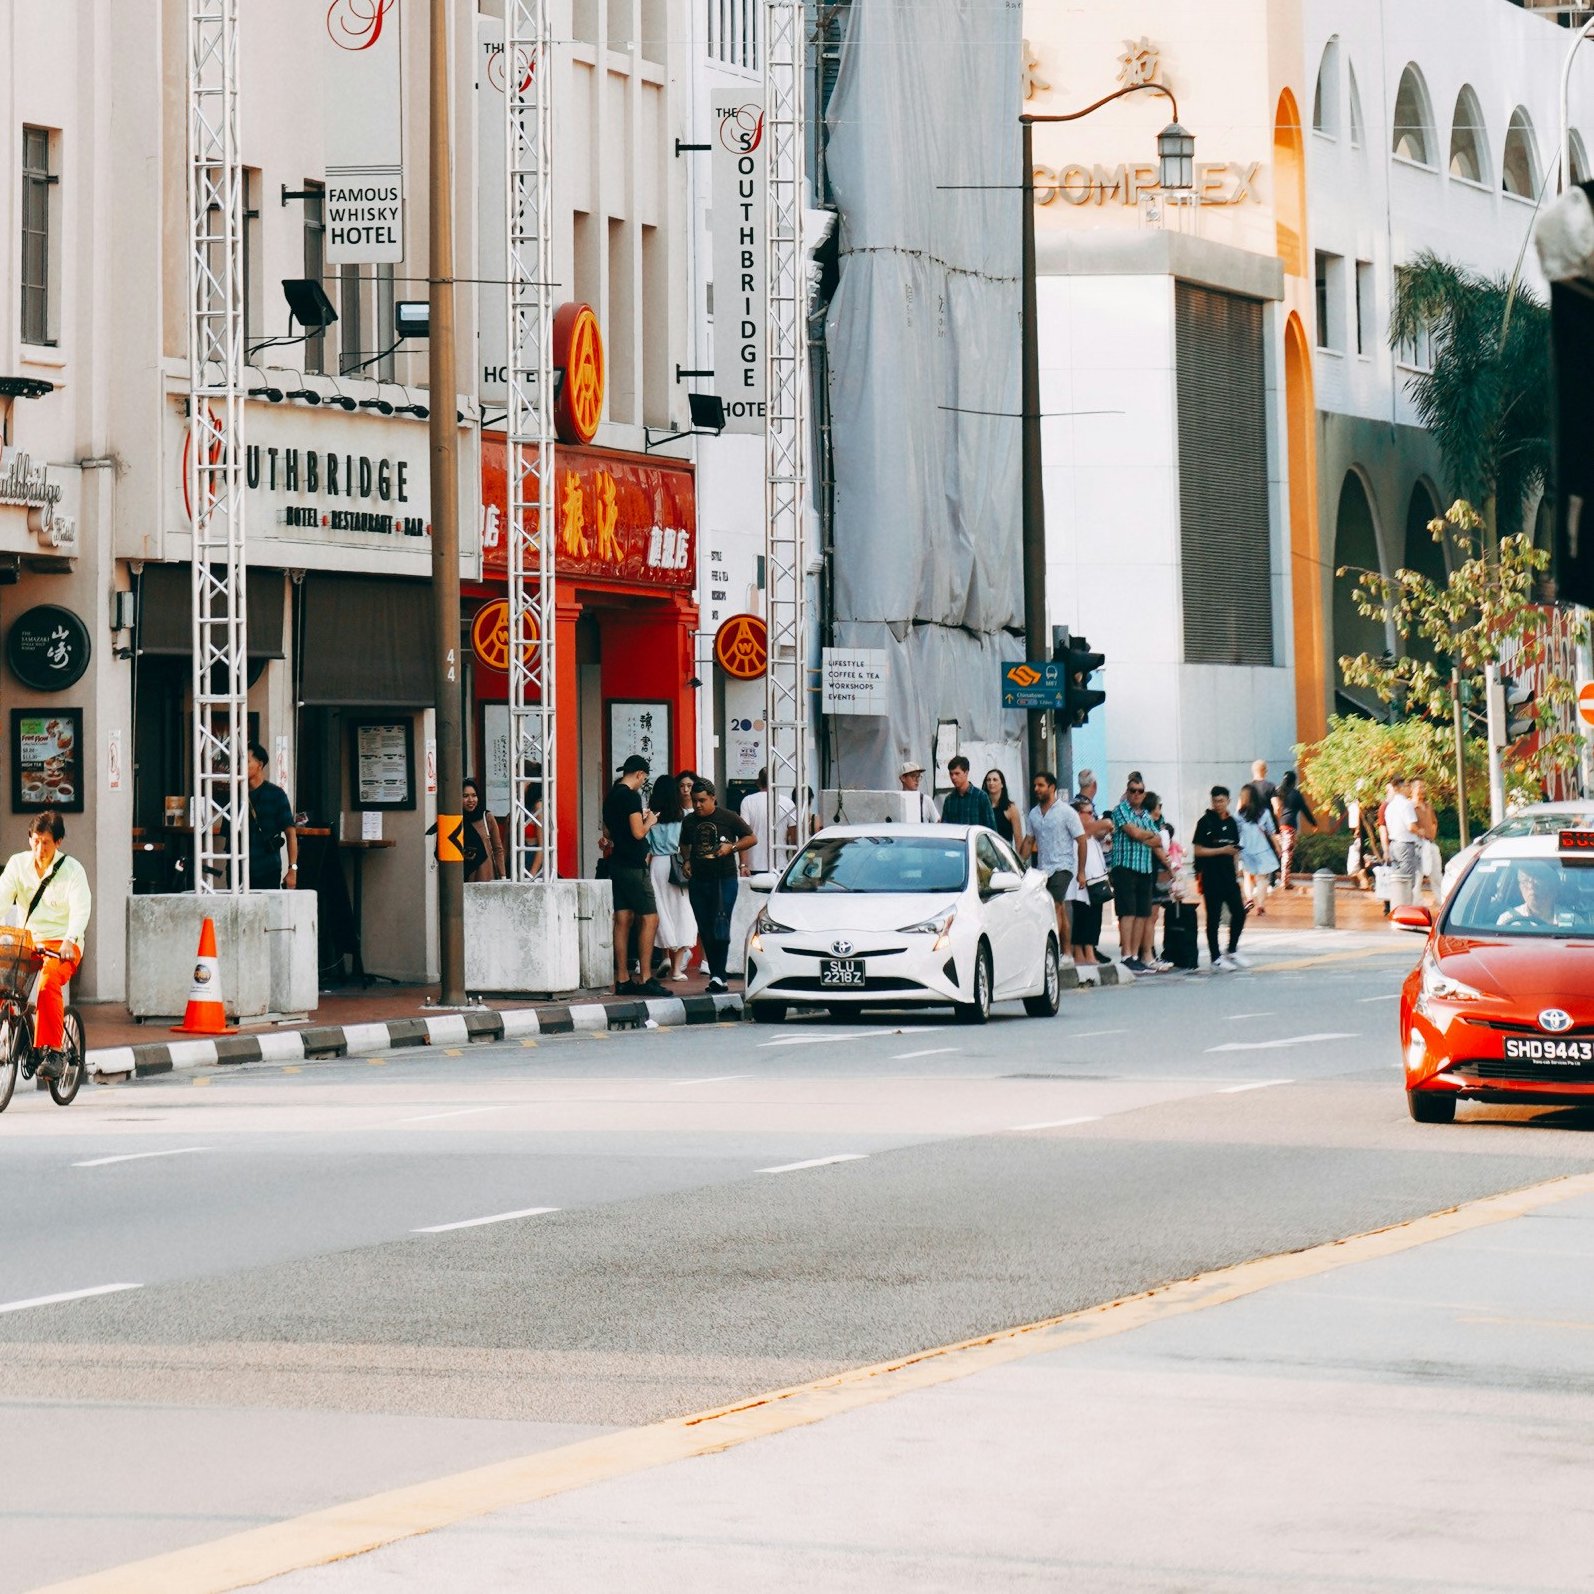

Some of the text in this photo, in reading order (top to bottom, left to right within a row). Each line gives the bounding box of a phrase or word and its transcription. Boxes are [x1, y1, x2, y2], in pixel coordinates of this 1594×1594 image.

[716, 108, 737, 118] THE
[1032, 161, 1263, 206] COMPEX
[329, 188, 398, 203] FAMOUS
[329, 207, 399, 221] WHISKY
[331, 226, 397, 245] HOTEL
[738, 132, 756, 387] SOUTHBRIDGE
[484, 366, 540, 383] HOE
[722, 402, 766, 417] HOTE
[209, 444, 408, 503] OUTHBRIDGE
[285, 506, 424, 537] HOTEL RESTAURANT BAR
[737, 642, 753, 654] W
[446, 648, 455, 682] 44
[828, 660, 865, 668] LIFESTYLE
[828, 671, 856, 679] COFFEE
[858, 671, 864, 679] &
[828, 682, 874, 690] WORKSHOPS
[828, 693, 856, 701] EVENTS
[830, 961, 855, 972] SLU
[1506, 1039, 1594, 1061] SHD9443
